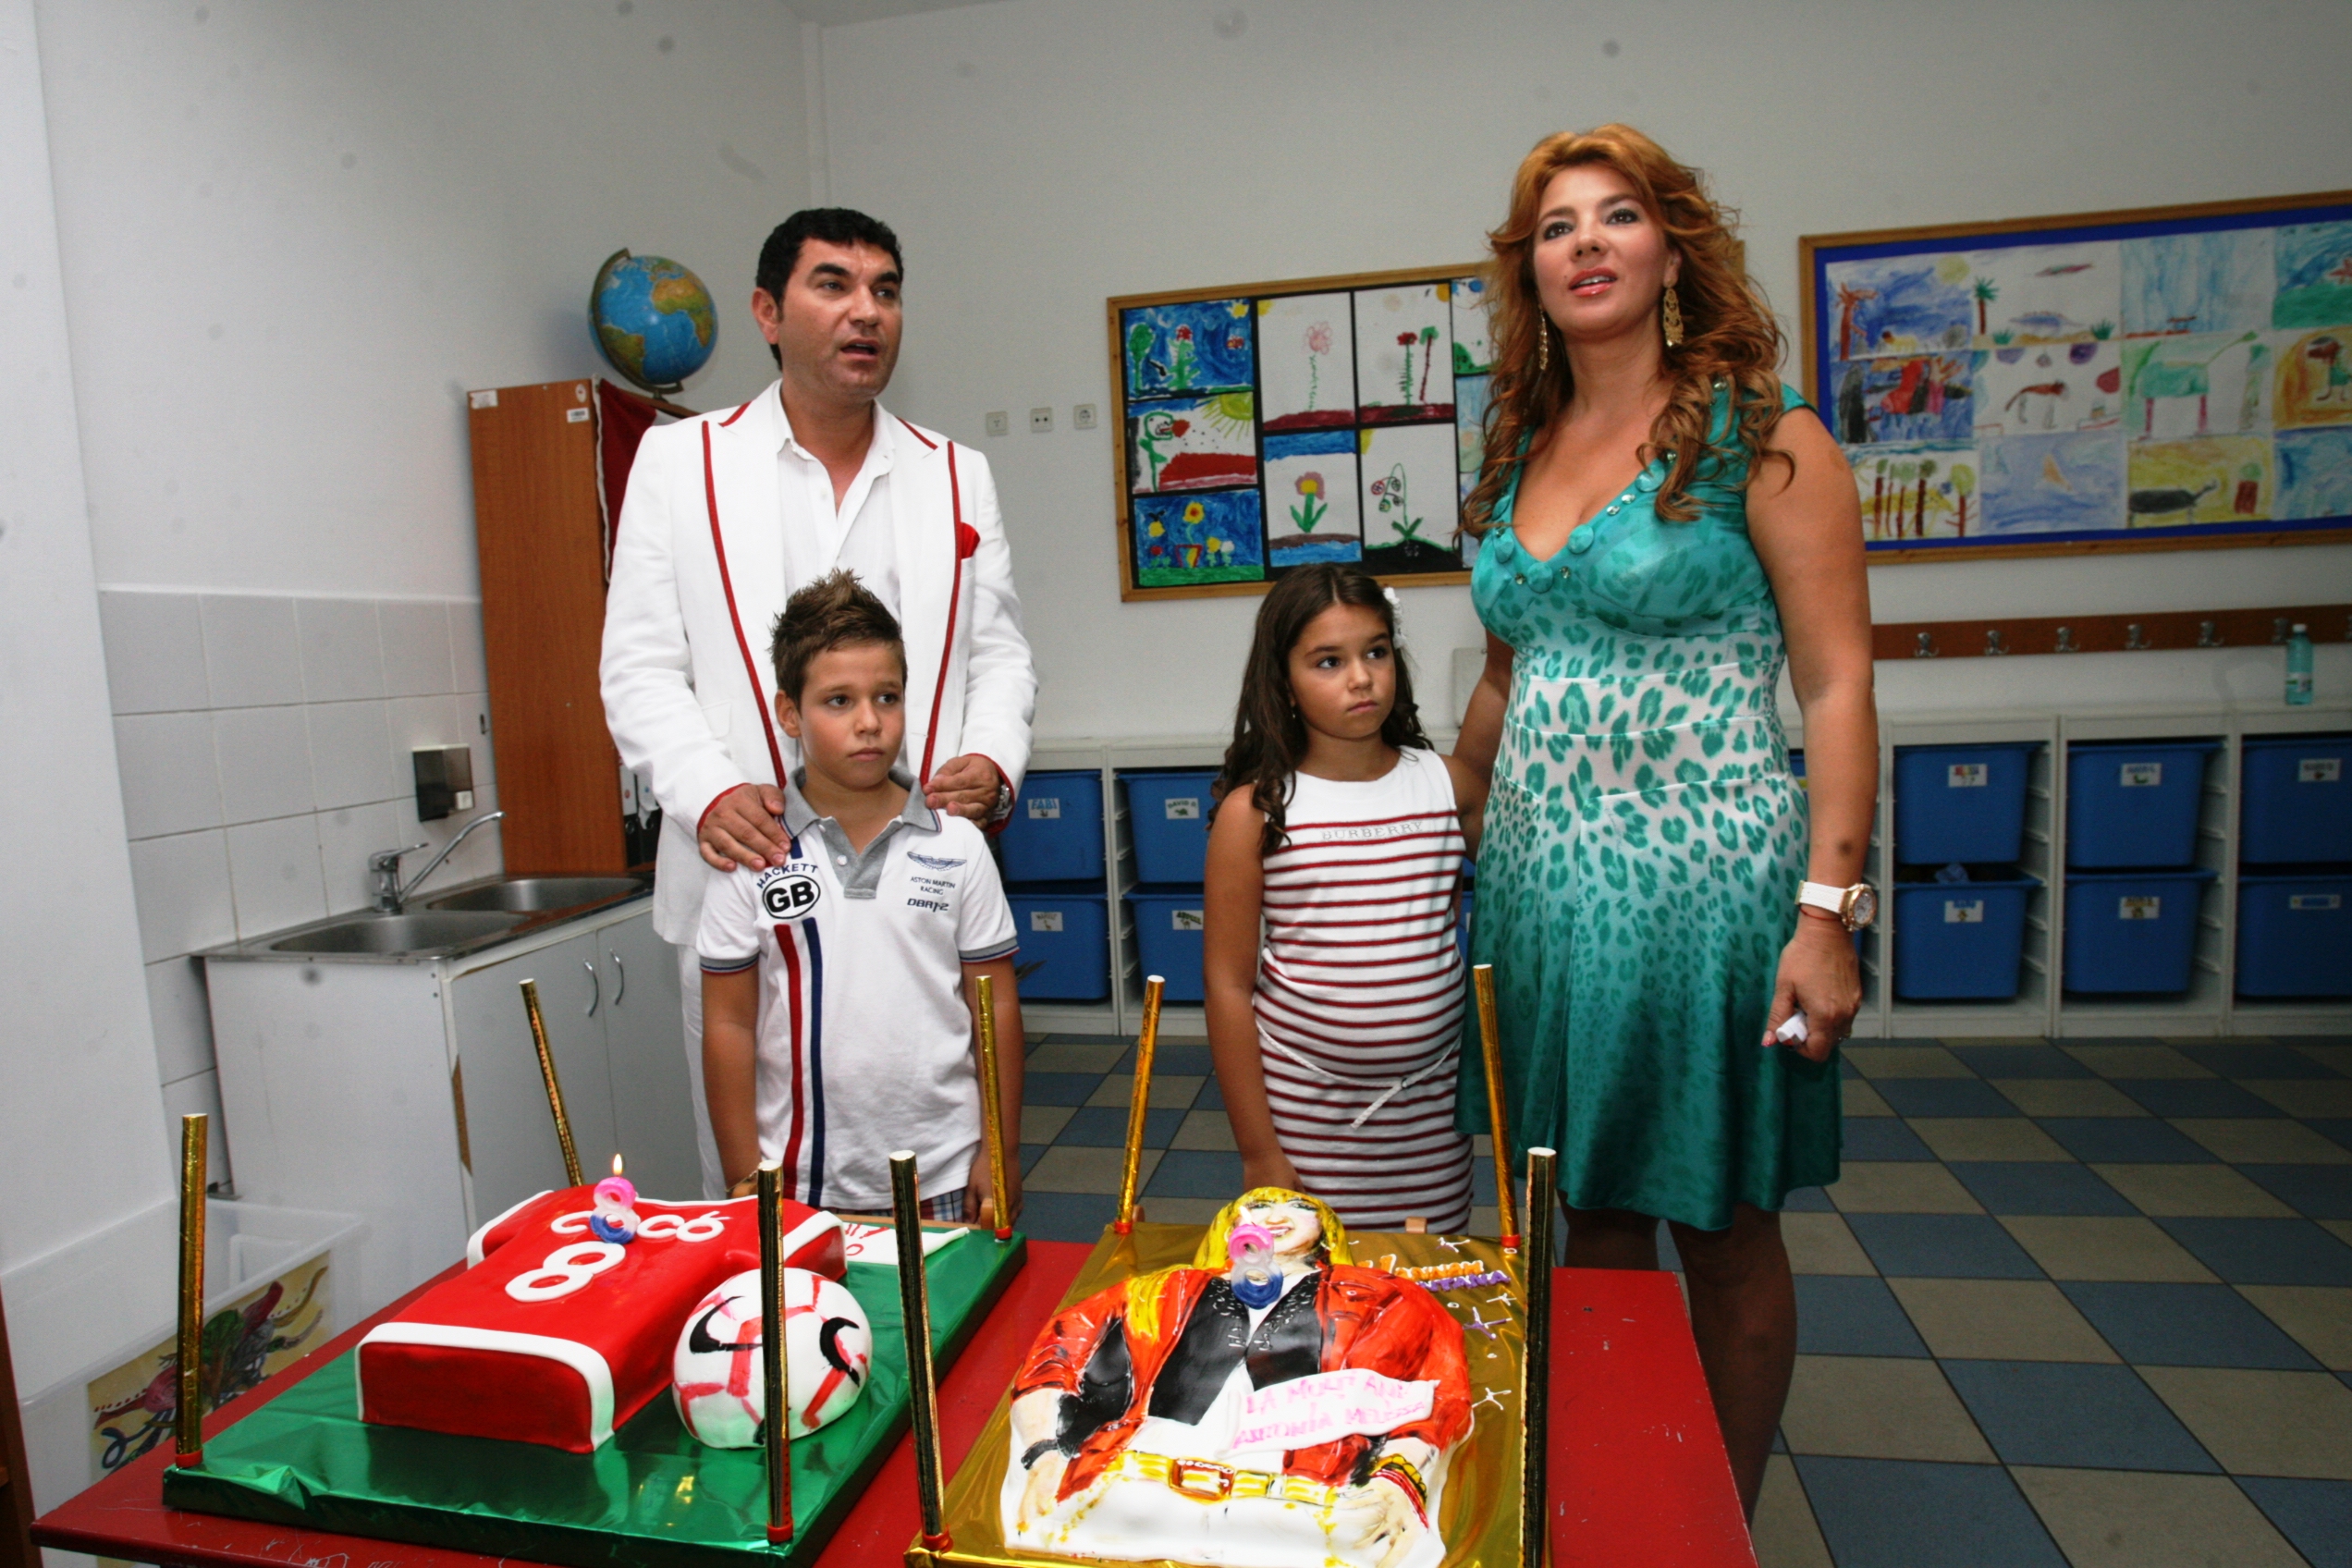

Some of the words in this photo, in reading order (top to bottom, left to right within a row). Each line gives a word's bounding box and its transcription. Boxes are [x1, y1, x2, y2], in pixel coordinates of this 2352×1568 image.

[1321, 821, 1424, 841] BURBERRY
[756, 863, 818, 889] HACKETT
[910, 876, 932, 885] ASTON
[932, 879, 956, 888] MARTIN
[766, 880, 815, 913] GB
[920, 885, 944, 895] RACING
[505, 1241, 626, 1303] 8
